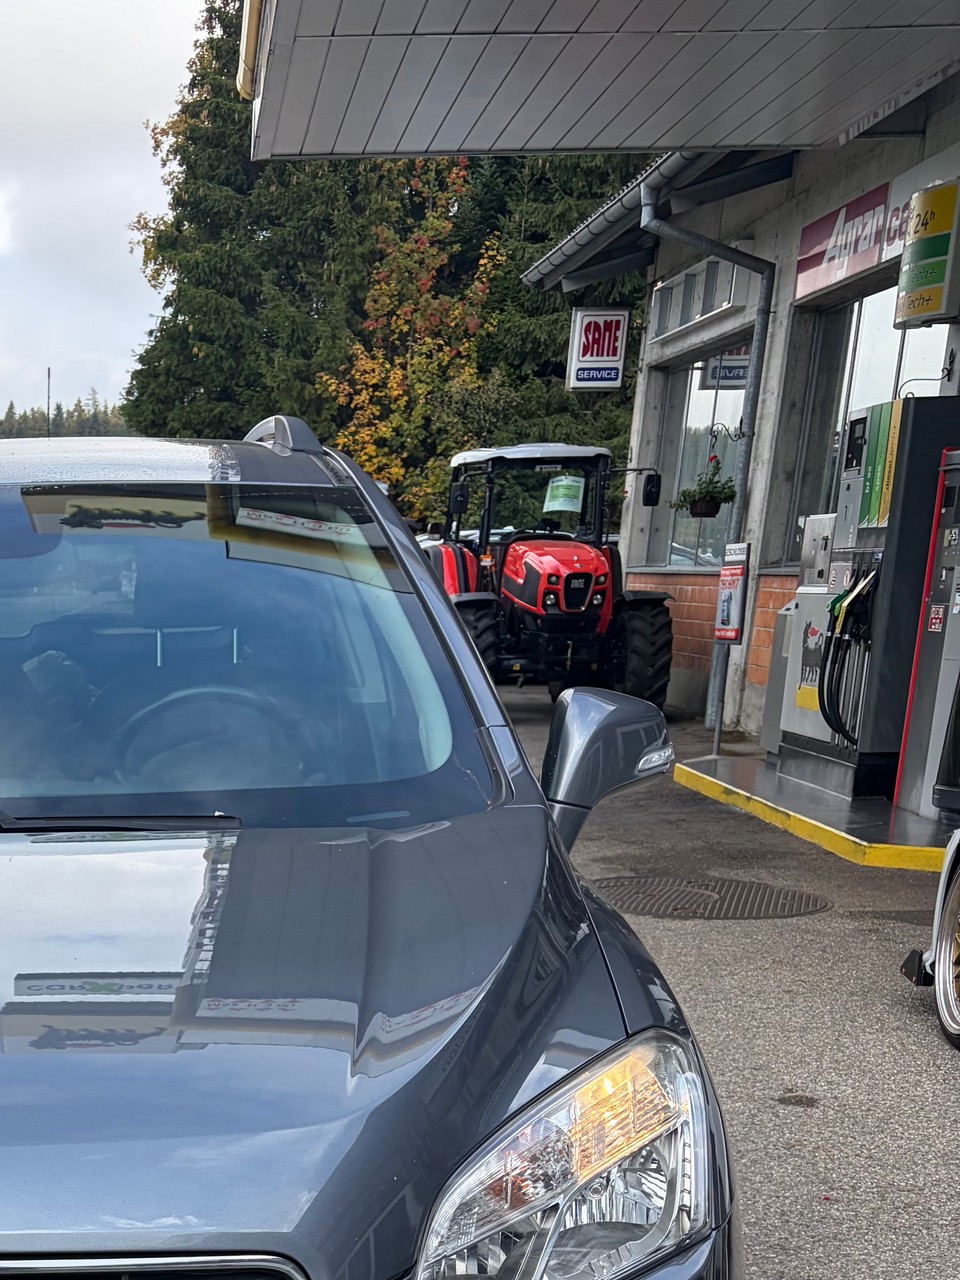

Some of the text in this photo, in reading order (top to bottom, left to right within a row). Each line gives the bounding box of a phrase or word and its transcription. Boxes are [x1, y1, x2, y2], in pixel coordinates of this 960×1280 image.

[821, 204, 886, 277] Agrar
[581, 319, 621, 358] SAME
[577, 369, 618, 379] SERVICE
